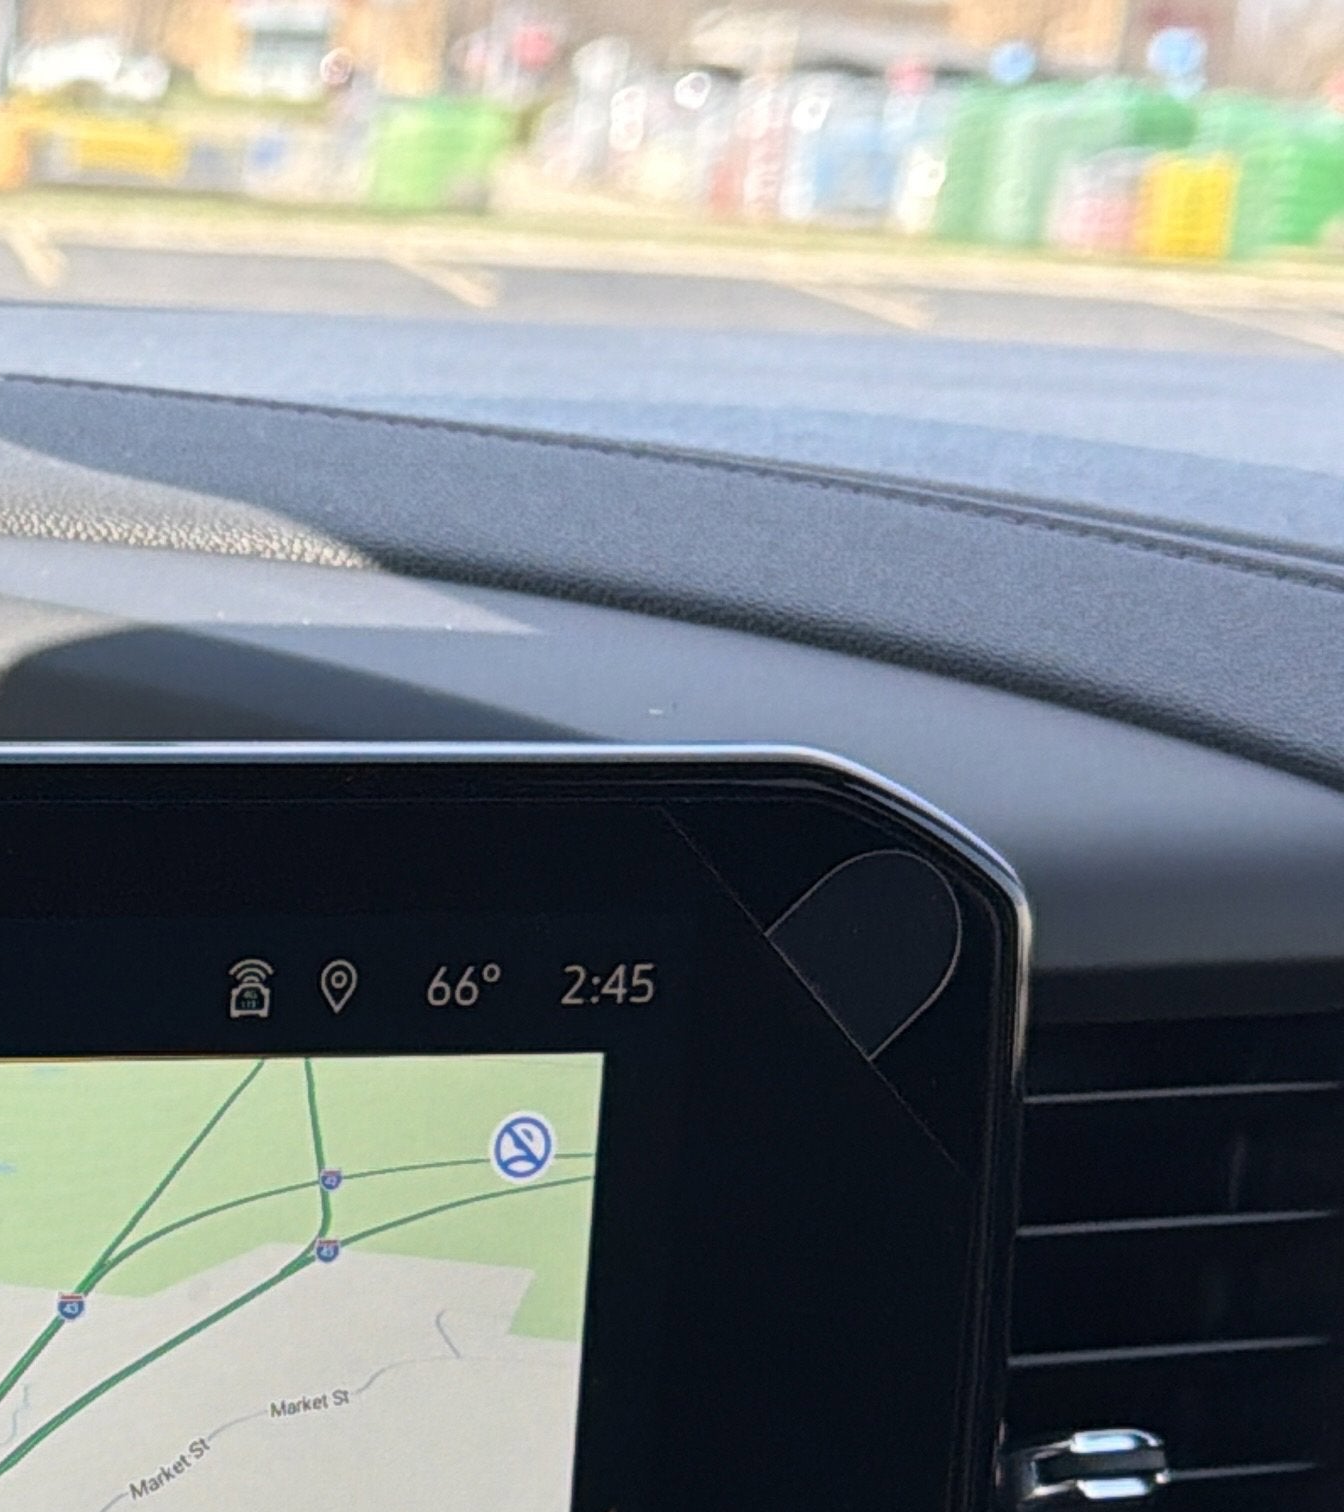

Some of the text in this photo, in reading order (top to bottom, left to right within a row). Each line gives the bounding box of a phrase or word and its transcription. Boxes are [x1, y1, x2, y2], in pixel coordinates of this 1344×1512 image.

[425, 962, 502, 1007] 66°
[560, 962, 657, 1006] 2:45
[270, 1389, 351, 1419] Market St
[128, 1437, 211, 1501] Market St
